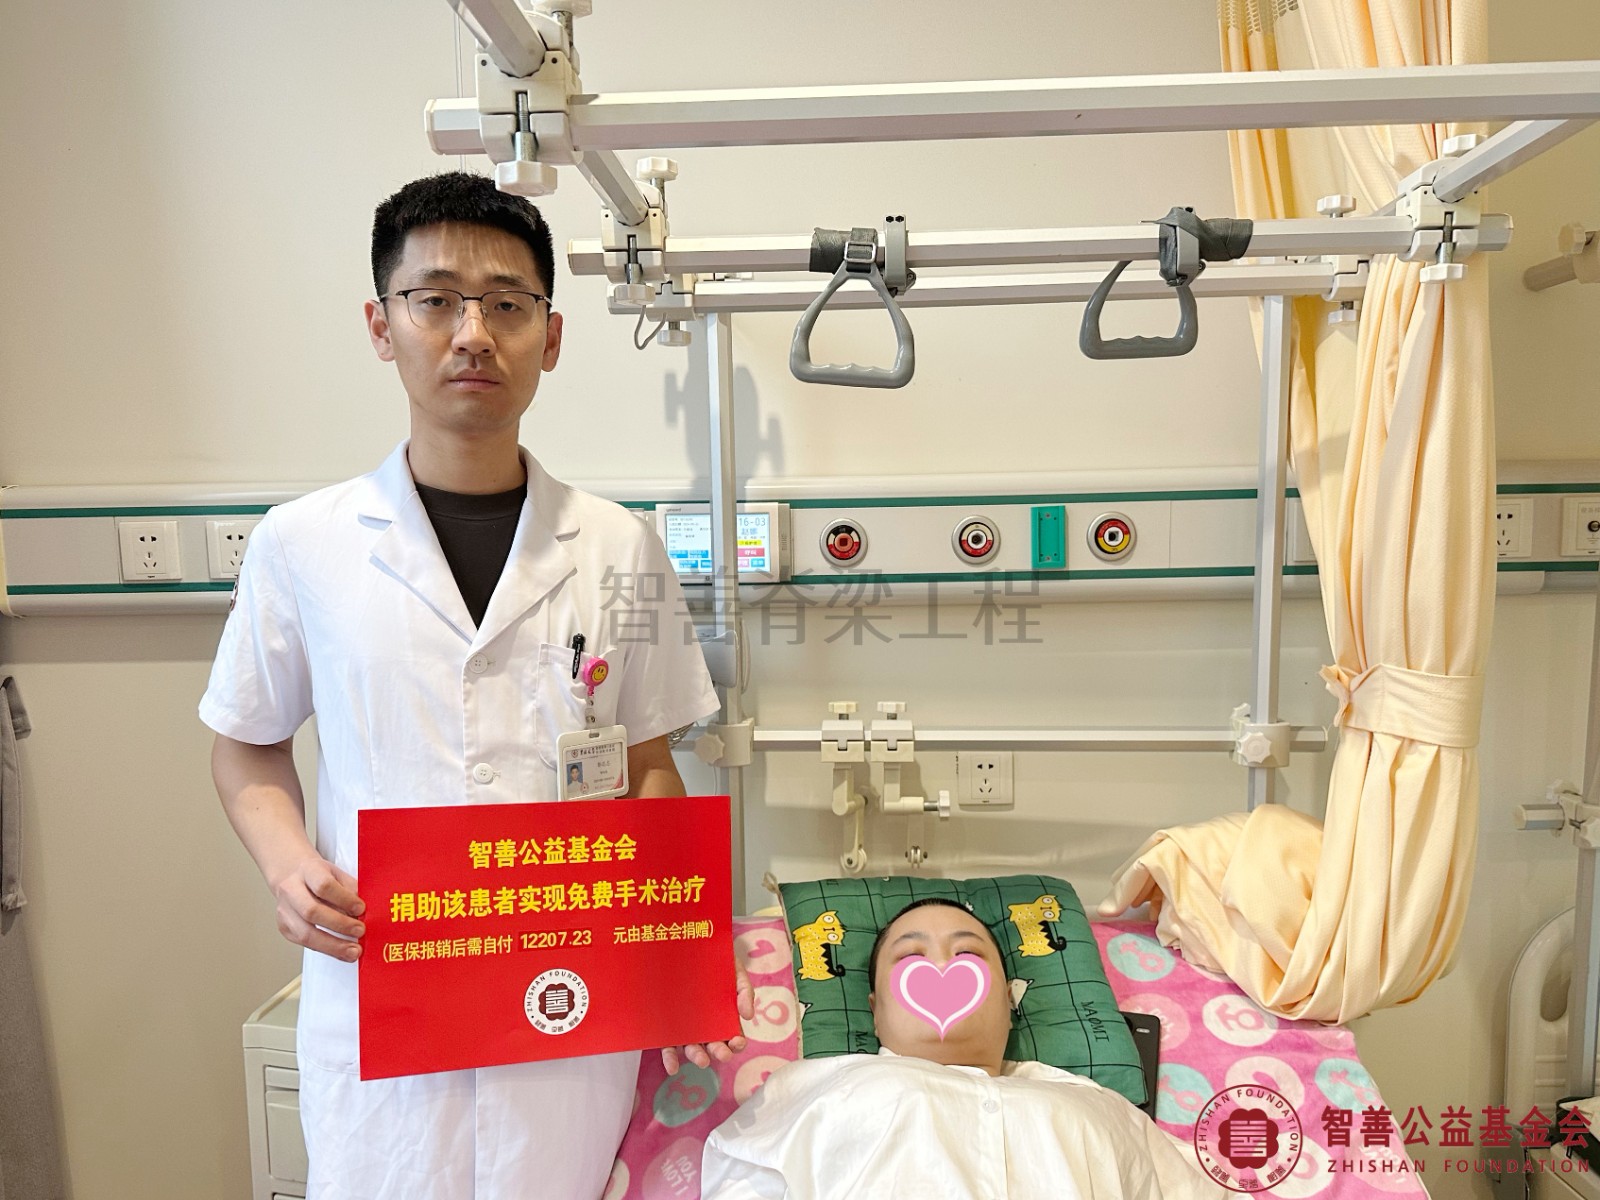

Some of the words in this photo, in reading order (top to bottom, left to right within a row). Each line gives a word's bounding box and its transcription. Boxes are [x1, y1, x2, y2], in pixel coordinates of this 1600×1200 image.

[468, 833, 637, 869] 智善公益基金会
[390, 875, 706, 922] 捐助该患者实现免费手术治疗
[382, 934, 513, 963] (医保报销后需自付
[520, 931, 592, 950] 12207.23
[612, 919, 715, 945] 元由基金会捐赠)
[527, 975, 546, 1012] ZHISHAN
[549, 970, 587, 1008] FOUNDATION
[1081, 1001, 1110, 1042] MAOMI
